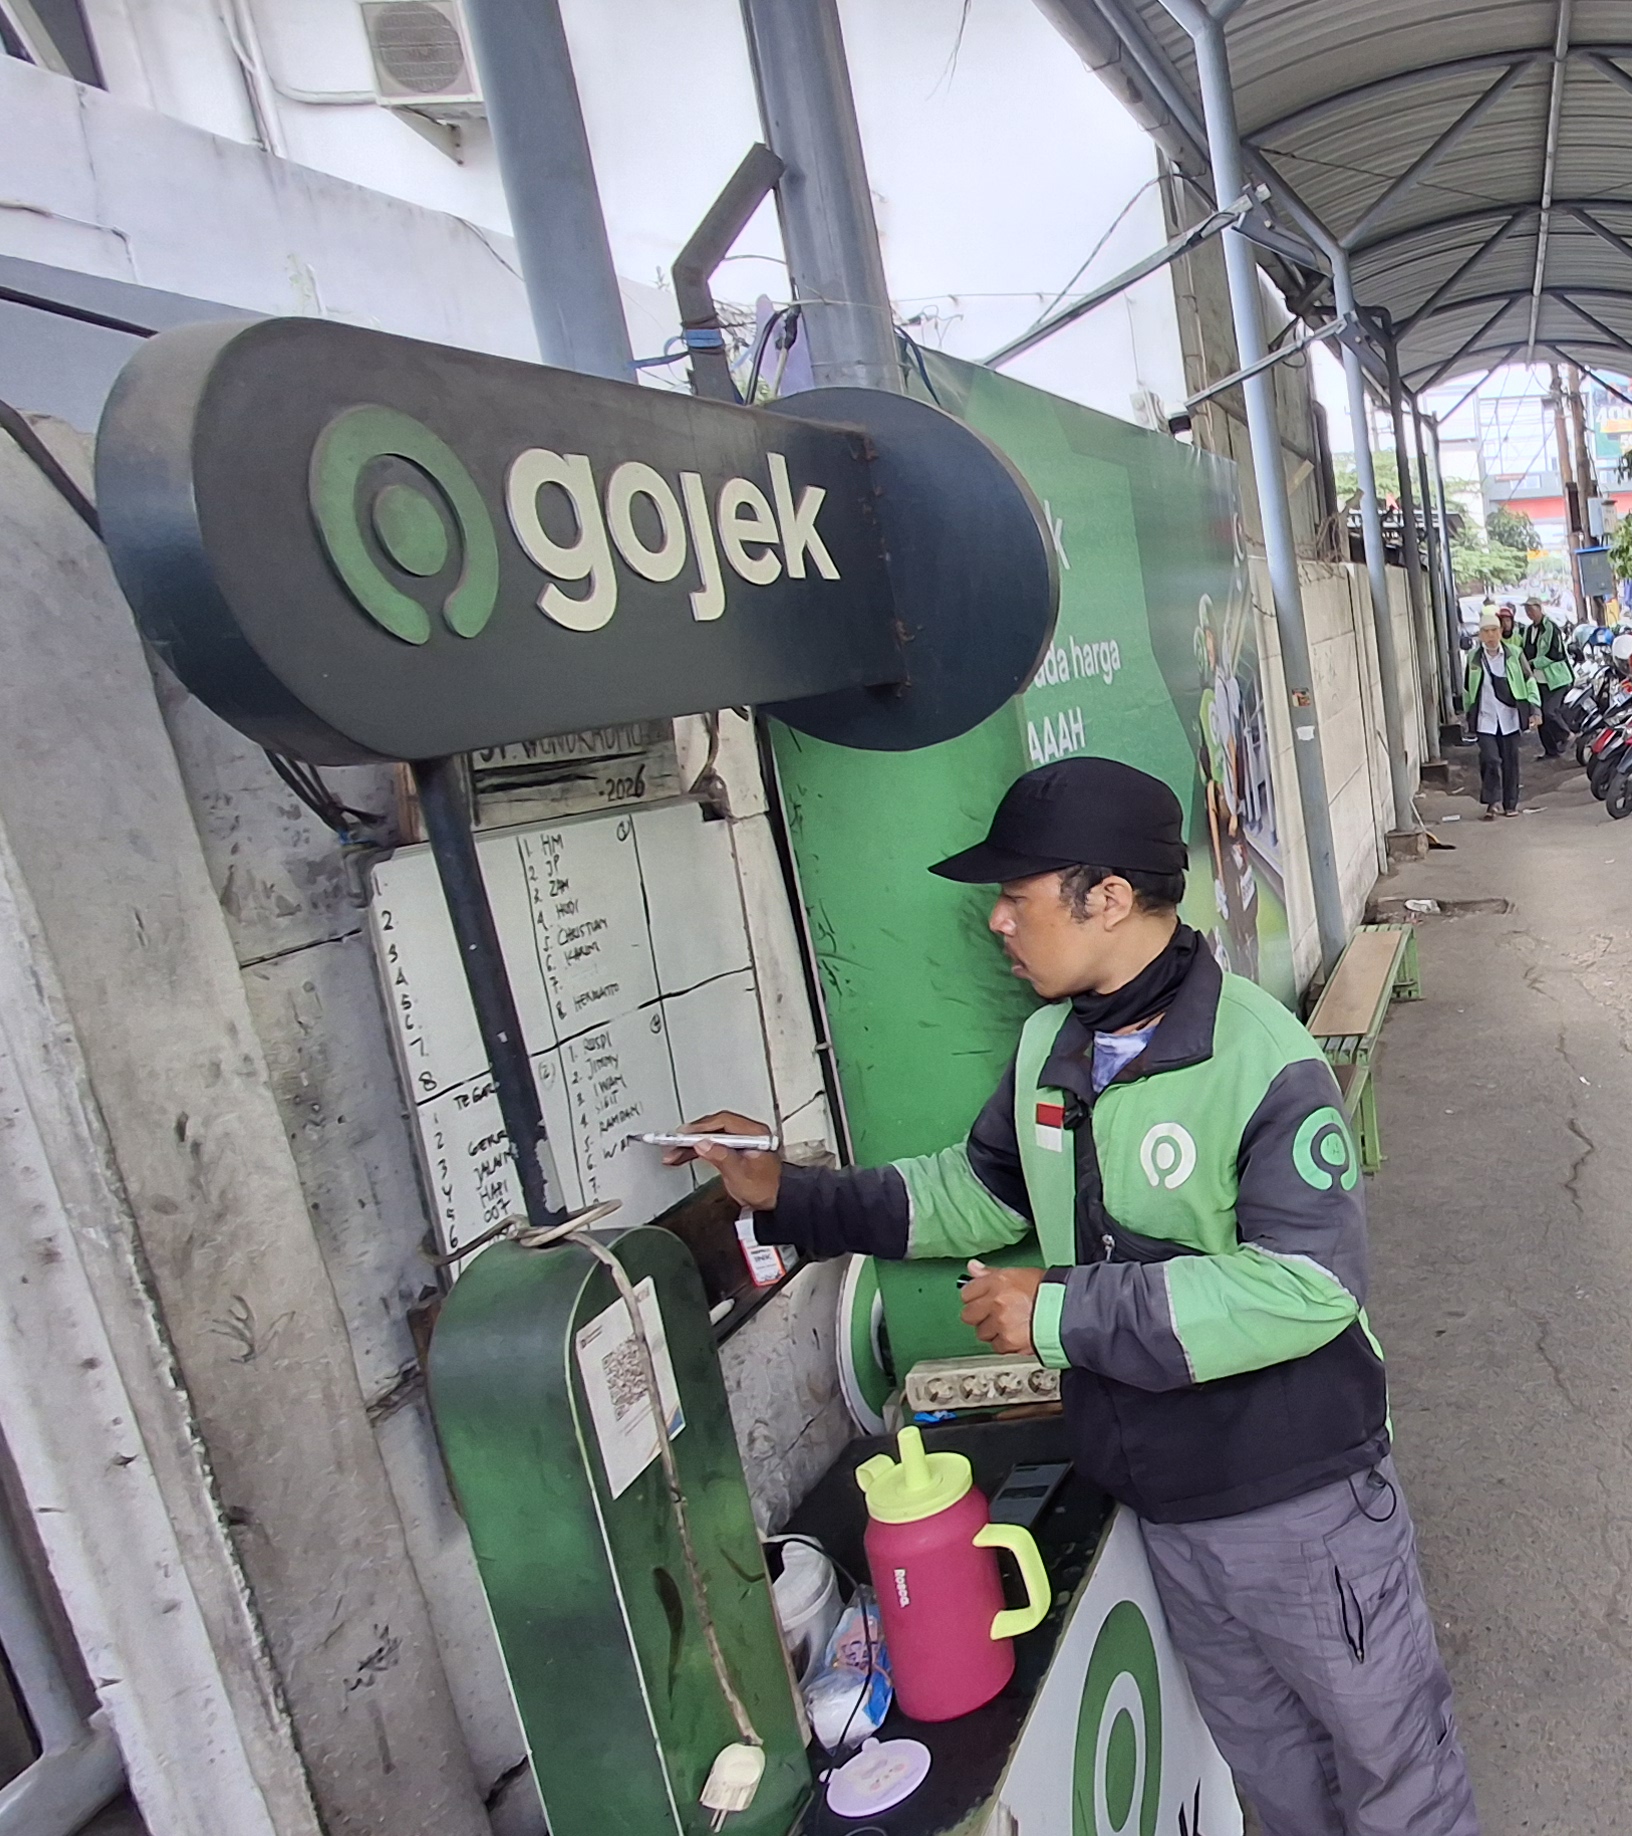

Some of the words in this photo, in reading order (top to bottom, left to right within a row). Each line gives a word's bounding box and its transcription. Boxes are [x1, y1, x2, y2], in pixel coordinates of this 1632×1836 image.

[507, 447, 841, 632] gojek
[1069, 634, 1122, 685] harga
[418, 1070, 437, 1092] 8
[433, 1131, 444, 1150] 2
[437, 1158, 448, 1180] 3
[449, 1224, 459, 1248] 6
